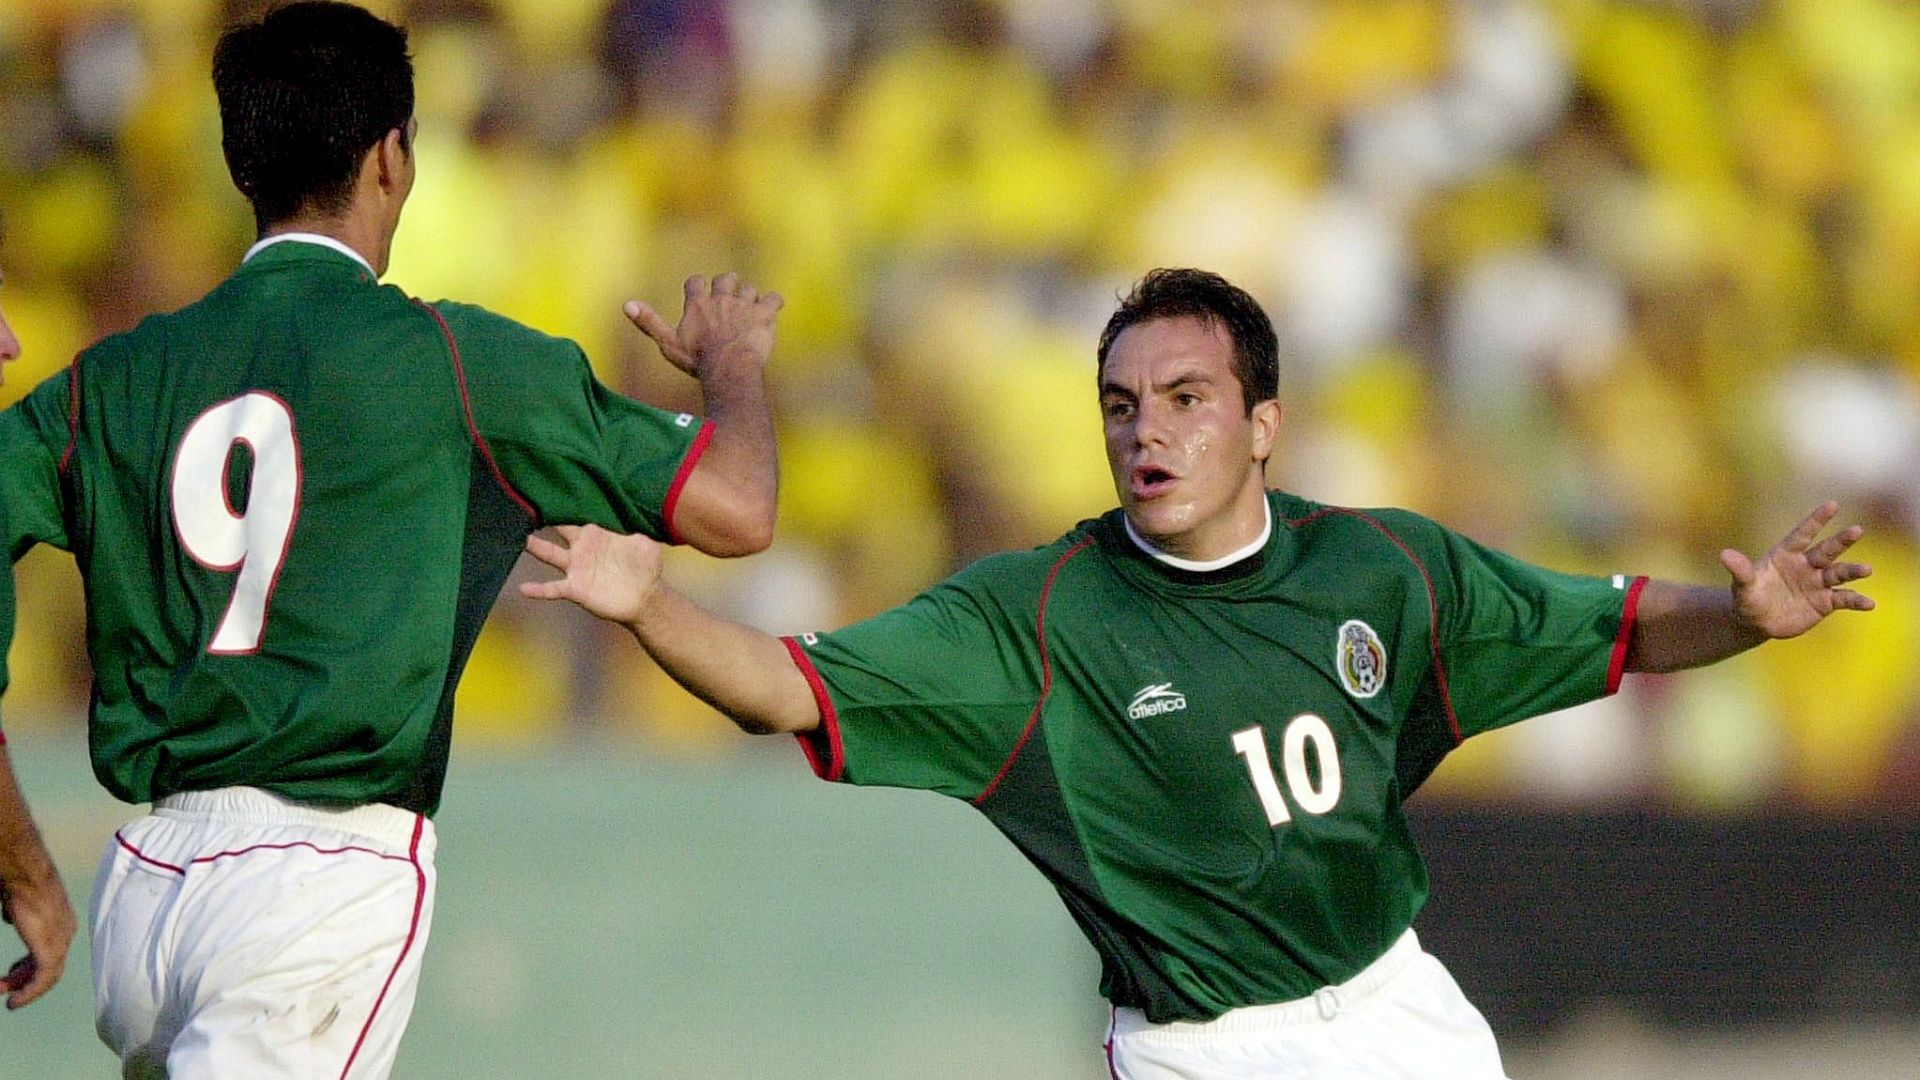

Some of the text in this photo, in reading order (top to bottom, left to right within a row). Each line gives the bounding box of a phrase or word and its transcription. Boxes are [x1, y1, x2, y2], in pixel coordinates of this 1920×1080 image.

[170, 390, 302, 655] 9
[1128, 697, 1188, 720] atletica
[1231, 713, 1343, 828] 10
